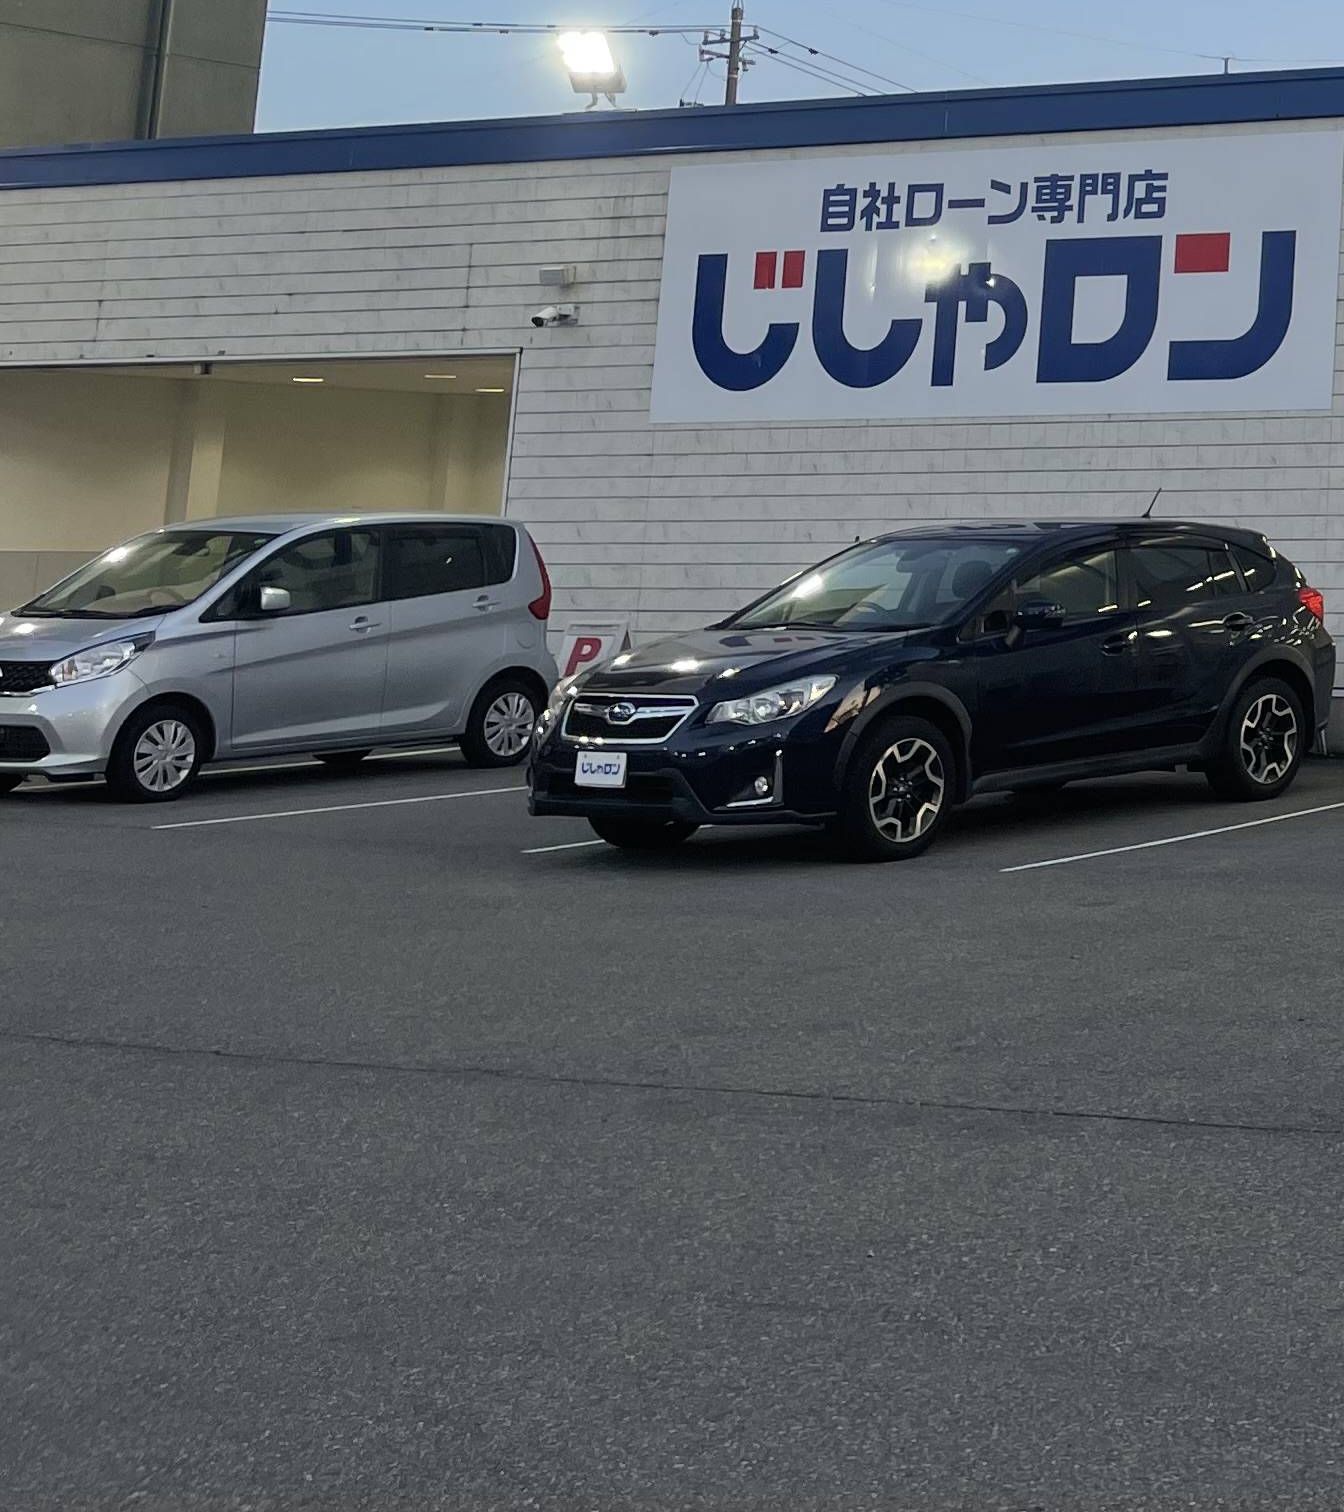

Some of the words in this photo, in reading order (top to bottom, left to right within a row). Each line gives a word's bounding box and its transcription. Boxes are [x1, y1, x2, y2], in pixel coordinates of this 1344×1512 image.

[820, 168, 1169, 233] 自社ローン専門店
[563, 637, 602, 678] P
